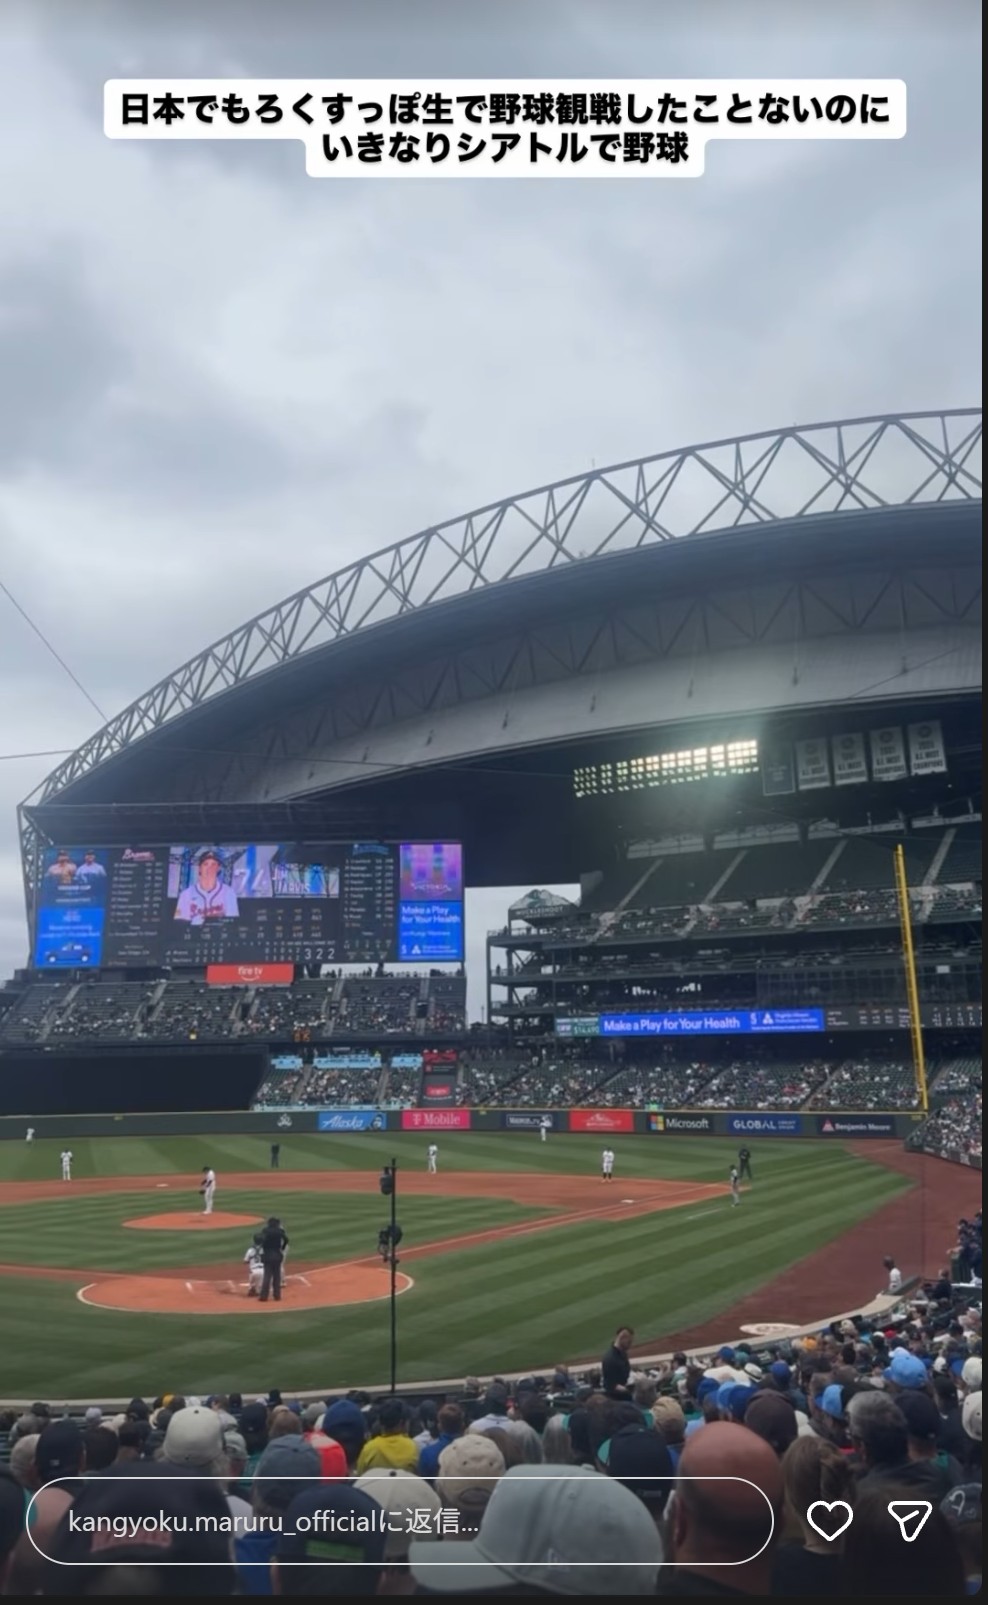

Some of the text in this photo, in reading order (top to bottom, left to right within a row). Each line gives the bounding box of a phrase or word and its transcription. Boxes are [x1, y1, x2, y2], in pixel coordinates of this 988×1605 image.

[402, 905, 425, 914] Make
[432, 905, 450, 915] Play
[402, 915, 461, 924] for Your Health
[304, 948, 312, 960] 3
[316, 948, 323, 960] 2
[327, 948, 335, 960] 2
[238, 967, 263, 976] fire tv
[604, 1020, 632, 1033] Make
[633, 1022, 639, 1031] a
[640, 1019, 662, 1033] Play
[663, 1018, 678, 1030] for
[678, 1016, 703, 1030] Your
[704, 1015, 741, 1029] Health
[321, 1115, 364, 1128] Alaska
[424, 1113, 461, 1126] Mobile
[665, 1117, 709, 1129] Microsoft
[733, 1119, 777, 1131] GLOBAL
[834, 1123, 891, 1132] Benjamin Moore
